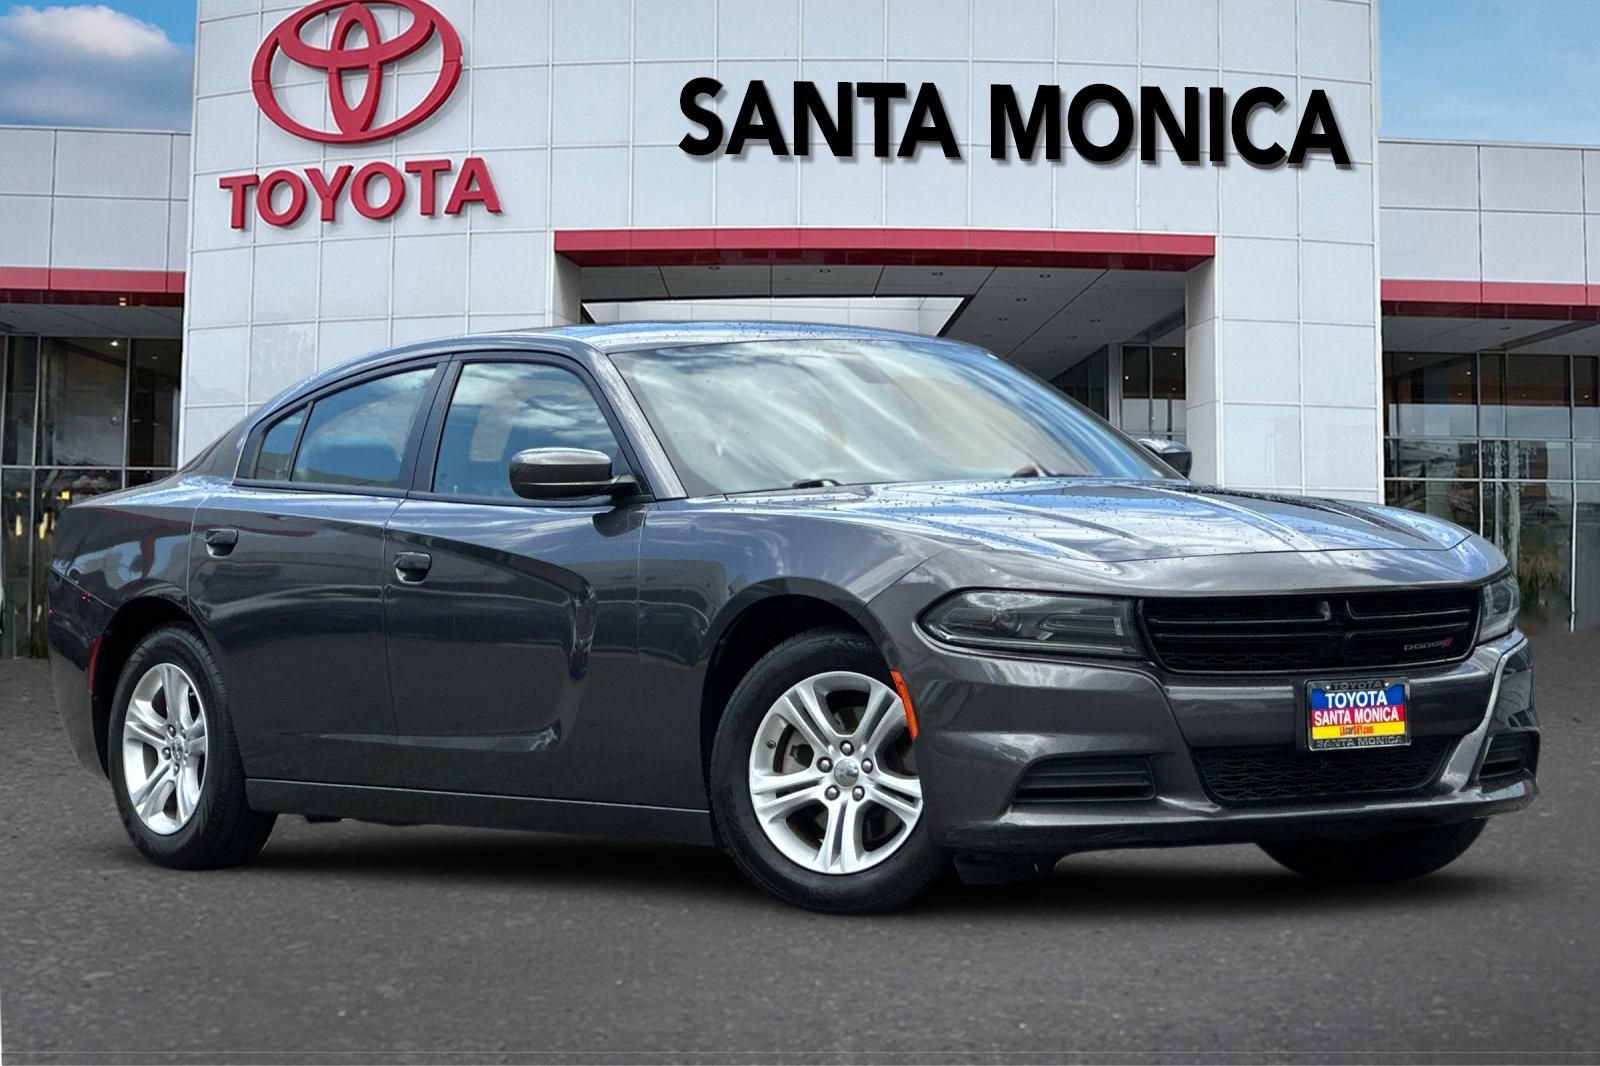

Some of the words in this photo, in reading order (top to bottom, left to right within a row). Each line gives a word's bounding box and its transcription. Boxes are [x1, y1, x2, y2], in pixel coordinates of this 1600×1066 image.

[678, 76, 961, 159] SANTA
[989, 83, 1352, 169] MONICA
[219, 157, 503, 230] TOYOTA
[1332, 681, 1382, 690] TOYOTA
[1325, 690, 1388, 708] TOYOTA
[1314, 709, 1352, 726] SANTA
[1355, 706, 1399, 724] MONICA
[1316, 738, 1355, 748] SANTA
[1357, 736, 1402, 746] MONICA
